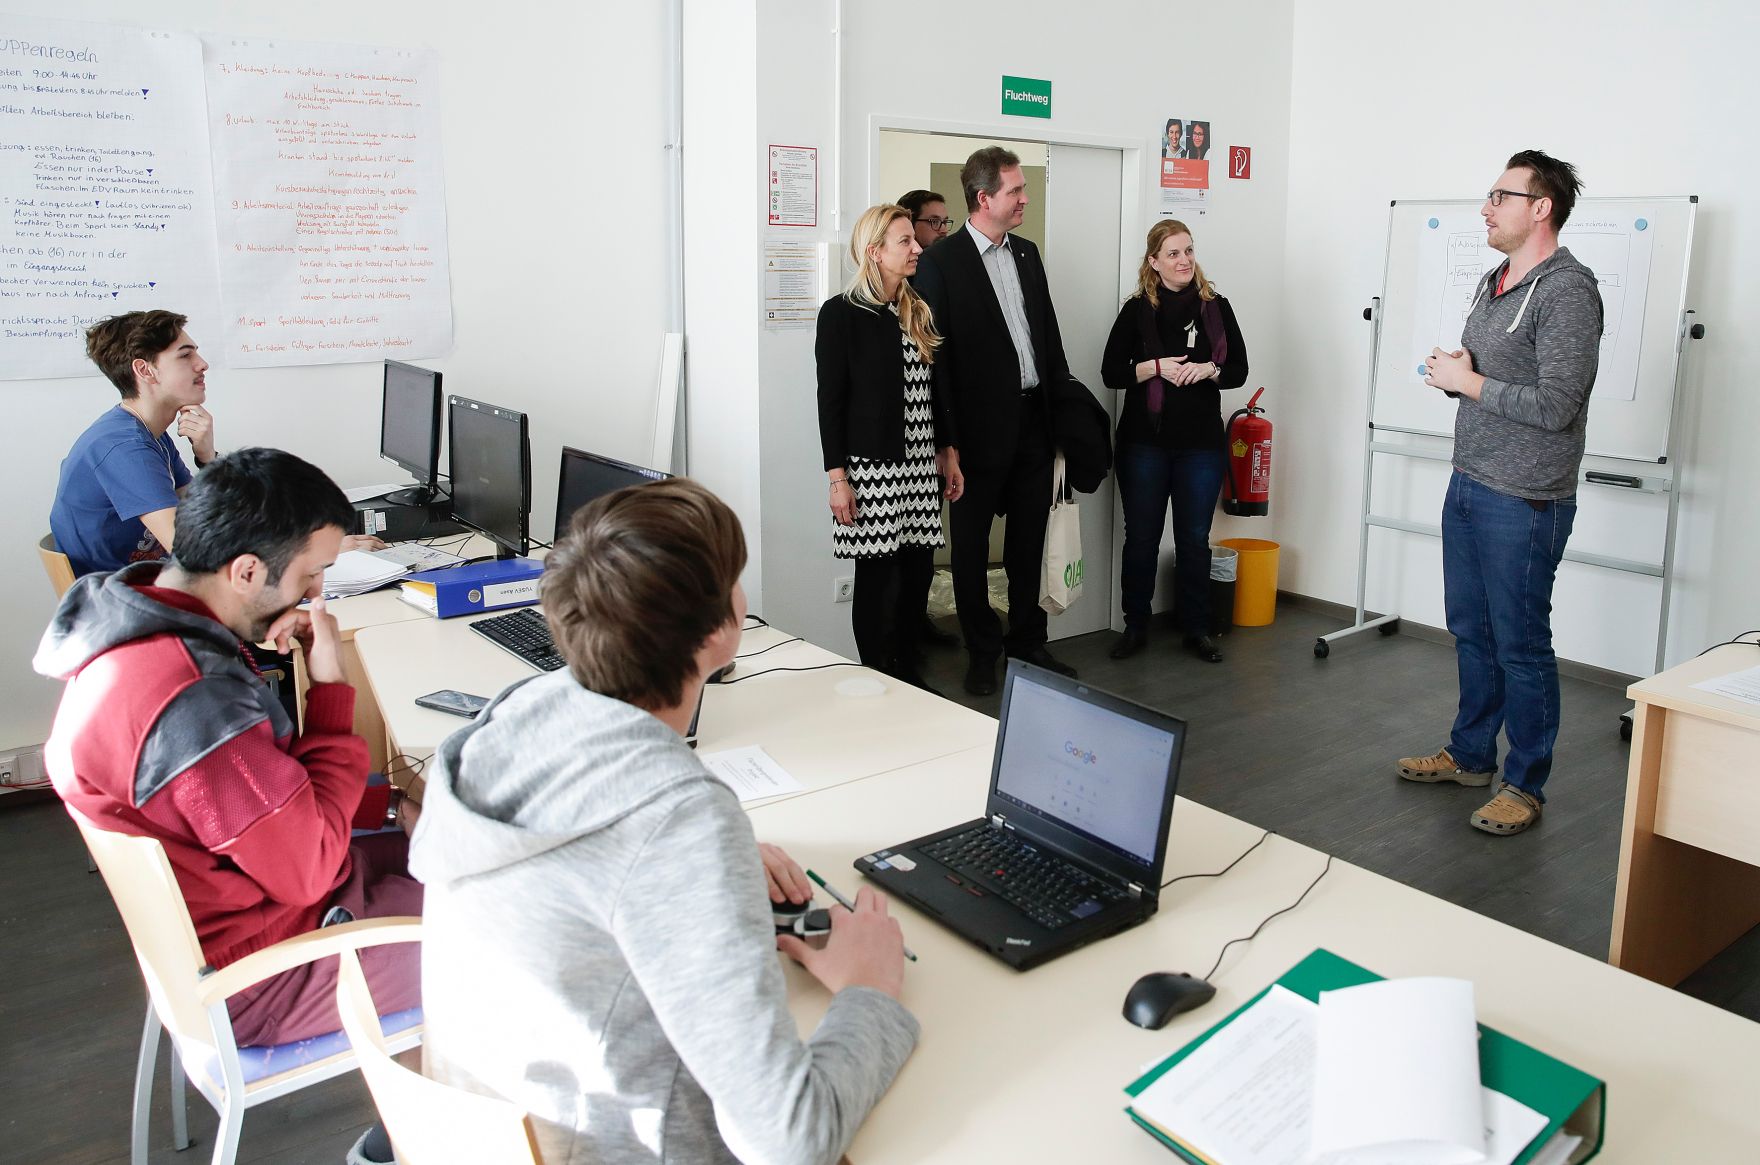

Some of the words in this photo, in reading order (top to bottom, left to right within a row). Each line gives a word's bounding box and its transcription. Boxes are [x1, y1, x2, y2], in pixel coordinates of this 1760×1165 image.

[82, 71, 98, 80] Uhr
[23, 84, 35, 92] bis
[1005, 89, 1048, 106] Fluchtweg
[30, 106, 93, 119] Arbeitsbereich
[50, 153, 86, 161] Rauchen
[67, 165, 83, 173] nur
[33, 173, 64, 182] Trinken
[113, 186, 139, 195] Raum
[13, 209, 39, 219] Musik
[28, 246, 44, 257] ab
[48, 246, 65, 259] (16)
[68, 250, 87, 259] nur
[108, 249, 128, 260] der
[46, 290, 70, 298] nach
[1064, 740, 1097, 765] Google
[1006, 937, 1032, 946] ThinkPad
